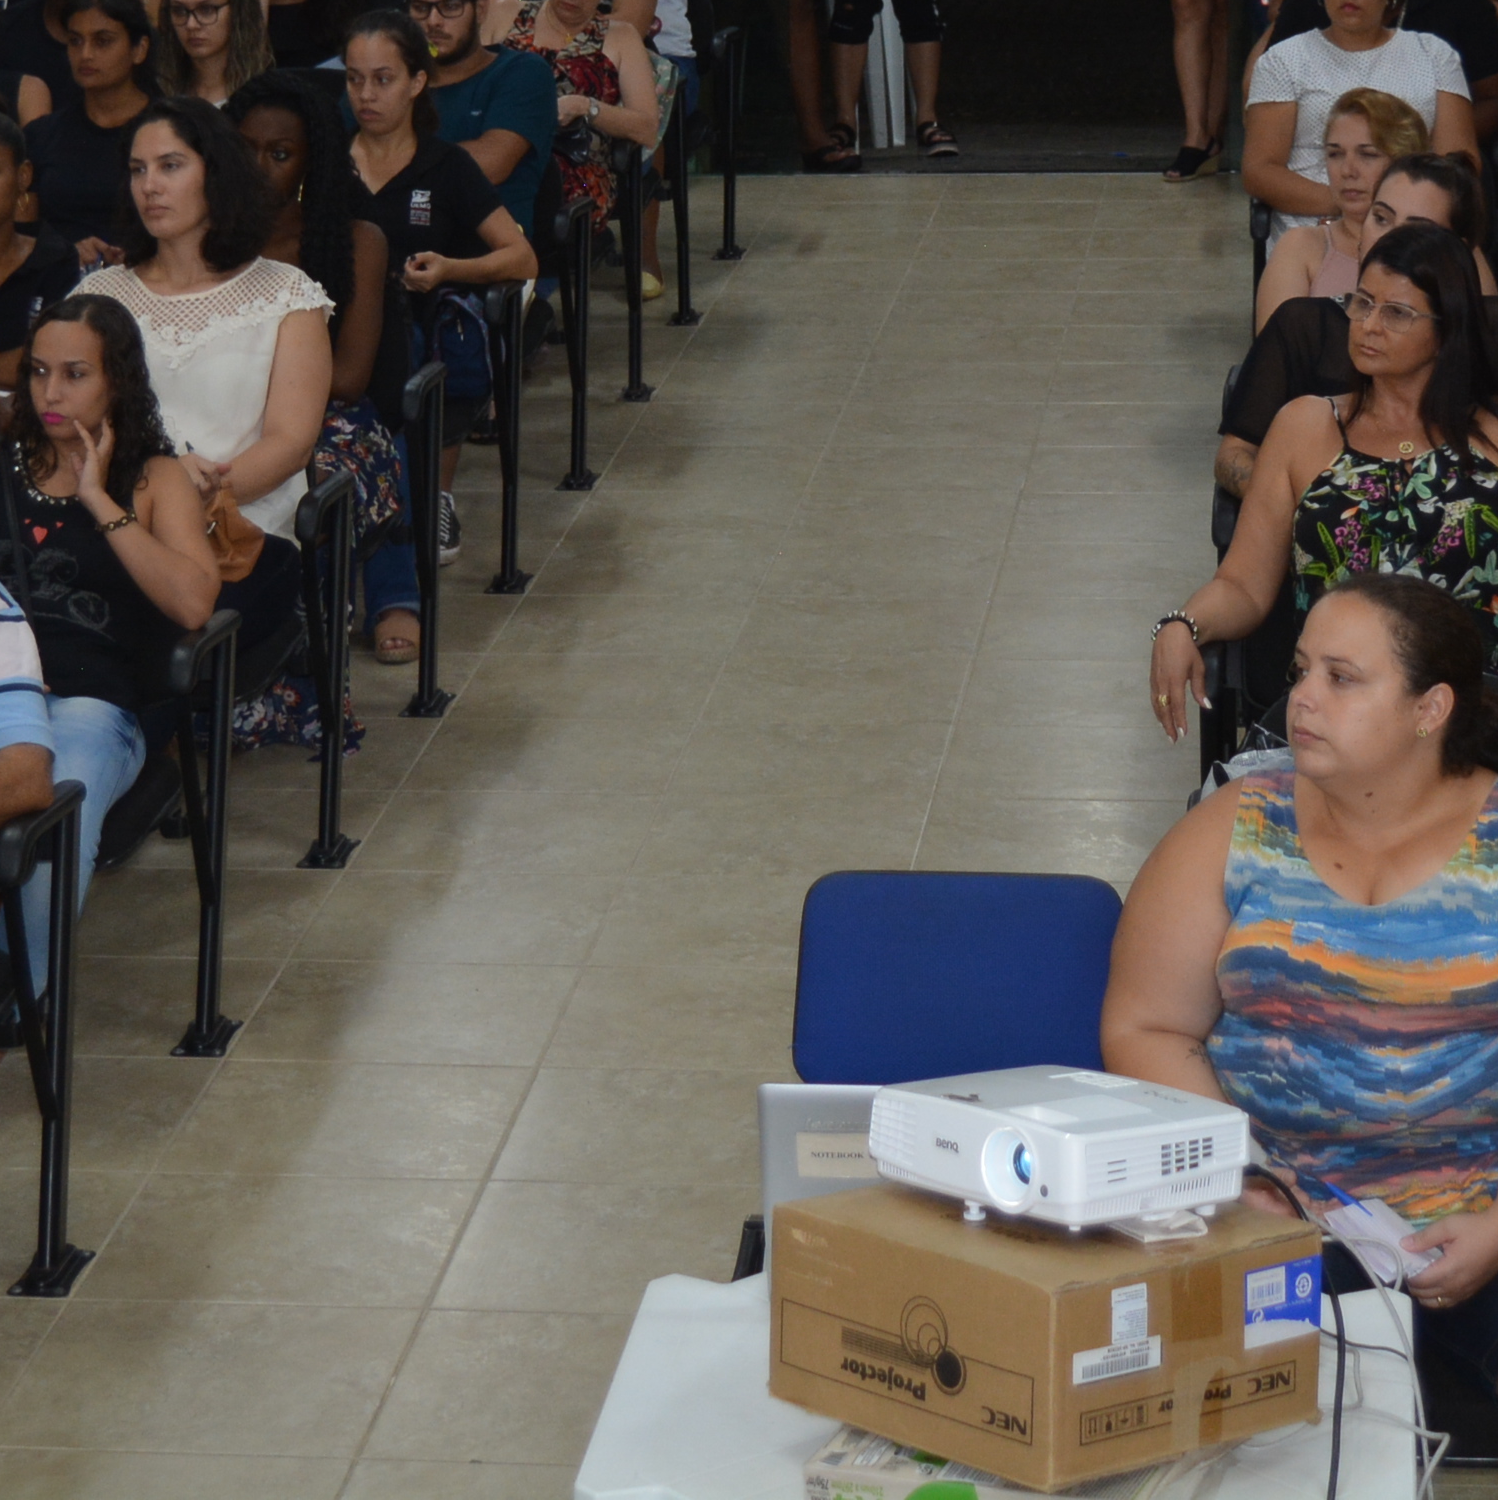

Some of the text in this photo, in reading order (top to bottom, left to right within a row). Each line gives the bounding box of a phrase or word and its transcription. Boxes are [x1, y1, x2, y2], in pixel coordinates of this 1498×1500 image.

[810, 1151, 865, 1159] NOTEBOOK
[841, 1356, 926, 1402] Projector
[1247, 1369, 1291, 1397] NEC
[981, 1405, 1028, 1437] NEC
